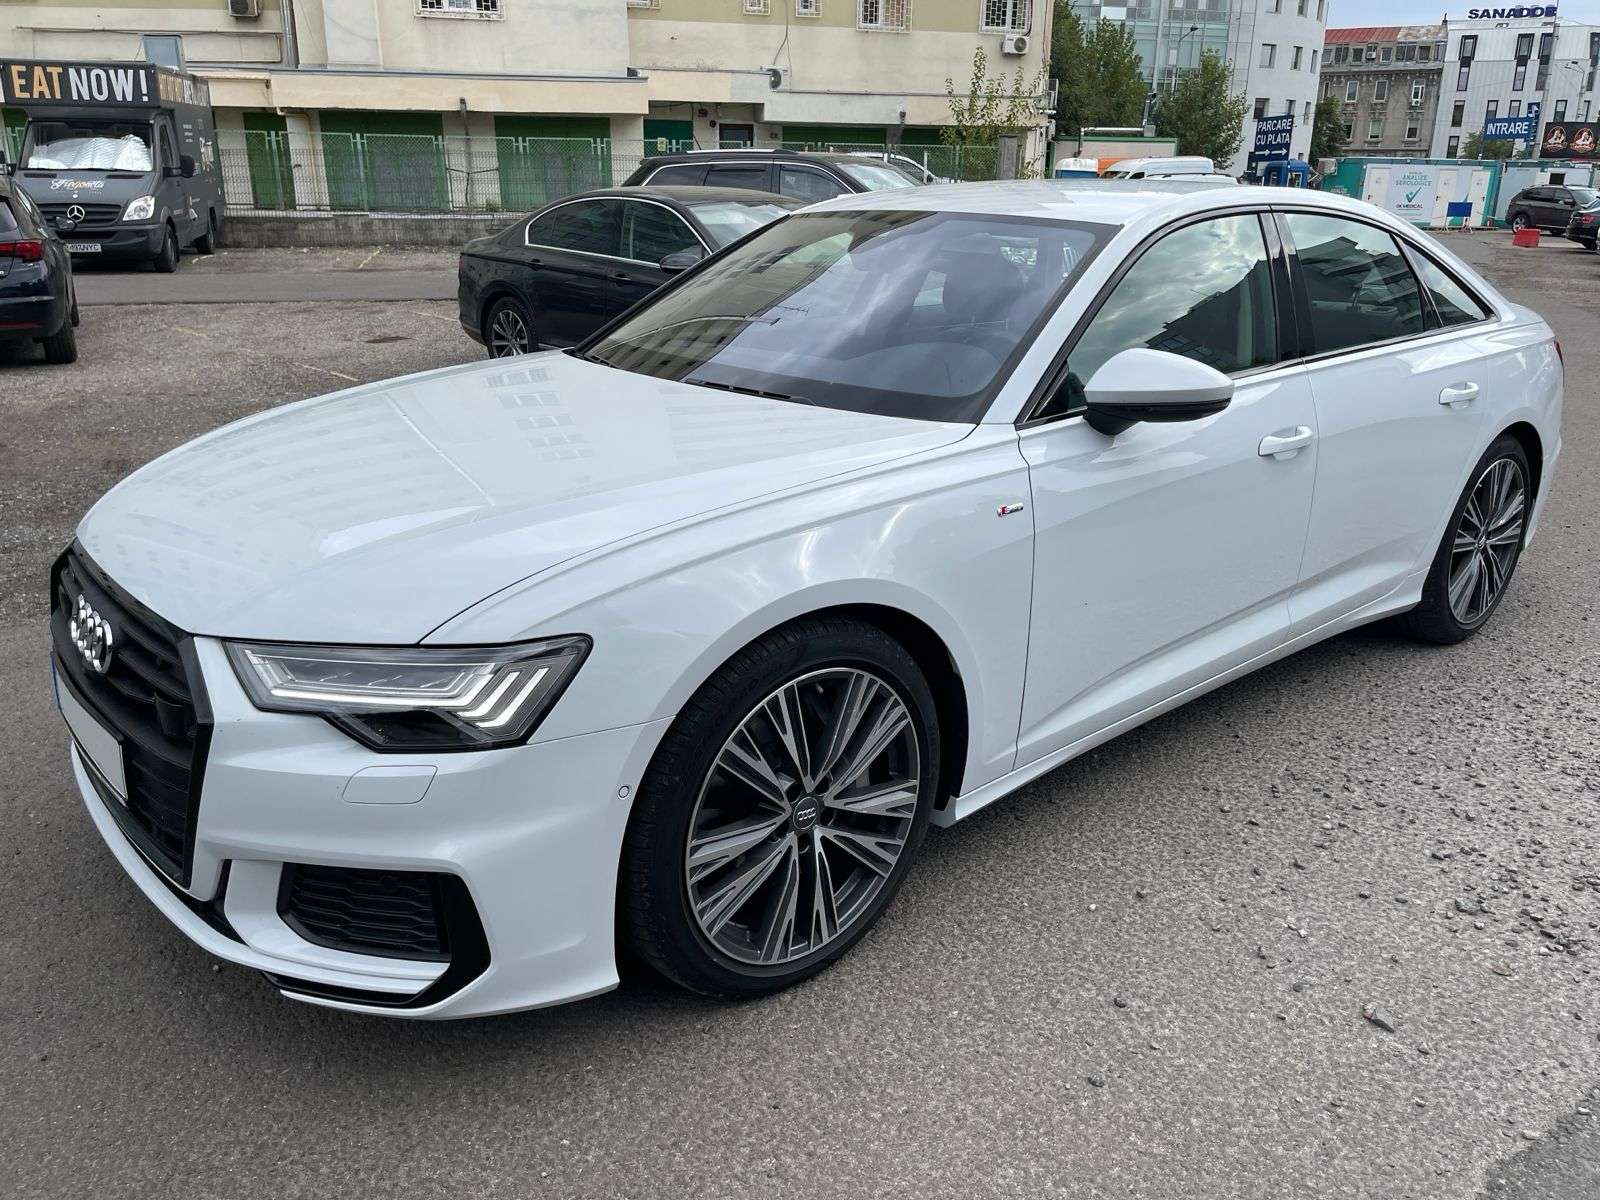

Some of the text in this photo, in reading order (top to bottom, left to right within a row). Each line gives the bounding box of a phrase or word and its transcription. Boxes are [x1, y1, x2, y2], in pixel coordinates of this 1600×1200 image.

[10, 64, 63, 99] EAT
[68, 67, 149, 102] NOW!
[1257, 119, 1292, 131] PARCARE
[1486, 122, 1530, 135] INTRARE
[1256, 133, 1290, 145] CU PLATA
